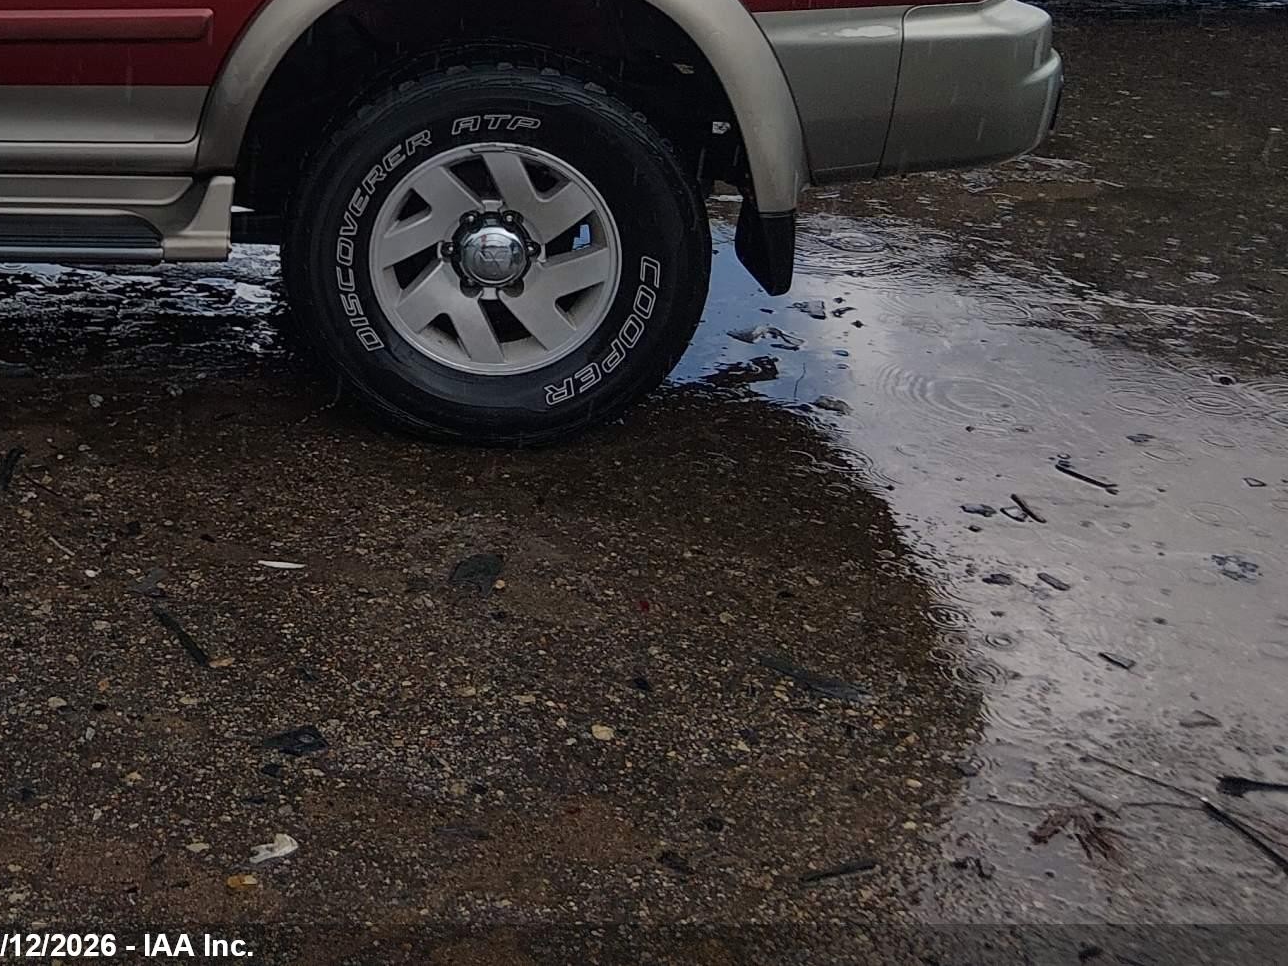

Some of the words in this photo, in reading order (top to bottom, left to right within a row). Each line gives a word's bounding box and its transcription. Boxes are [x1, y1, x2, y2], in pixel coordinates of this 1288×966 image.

[333, 129, 433, 353] DISCOVERER
[450, 113, 542, 135] ATP
[543, 256, 661, 406] COOPER
